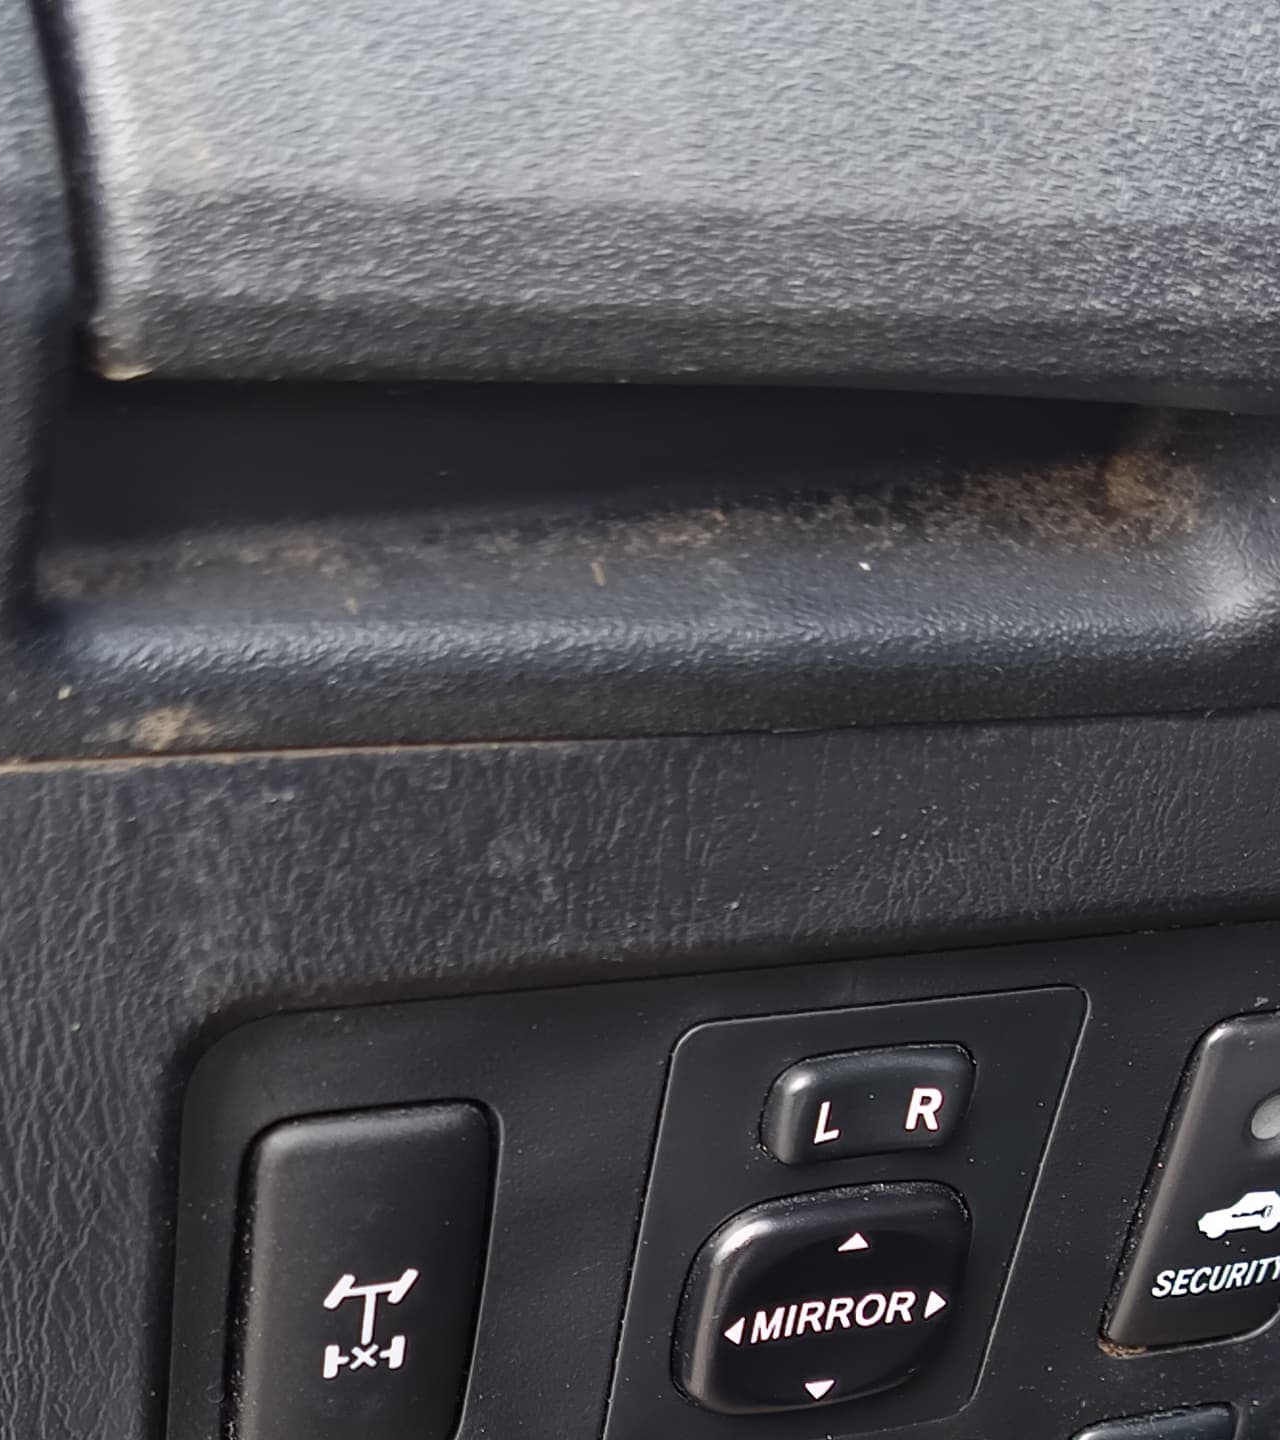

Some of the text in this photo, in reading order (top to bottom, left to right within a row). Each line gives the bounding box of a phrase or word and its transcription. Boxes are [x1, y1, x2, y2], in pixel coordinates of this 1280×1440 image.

[813, 1087, 943, 1144] L R
[750, 1290, 917, 1344] MIRROR
